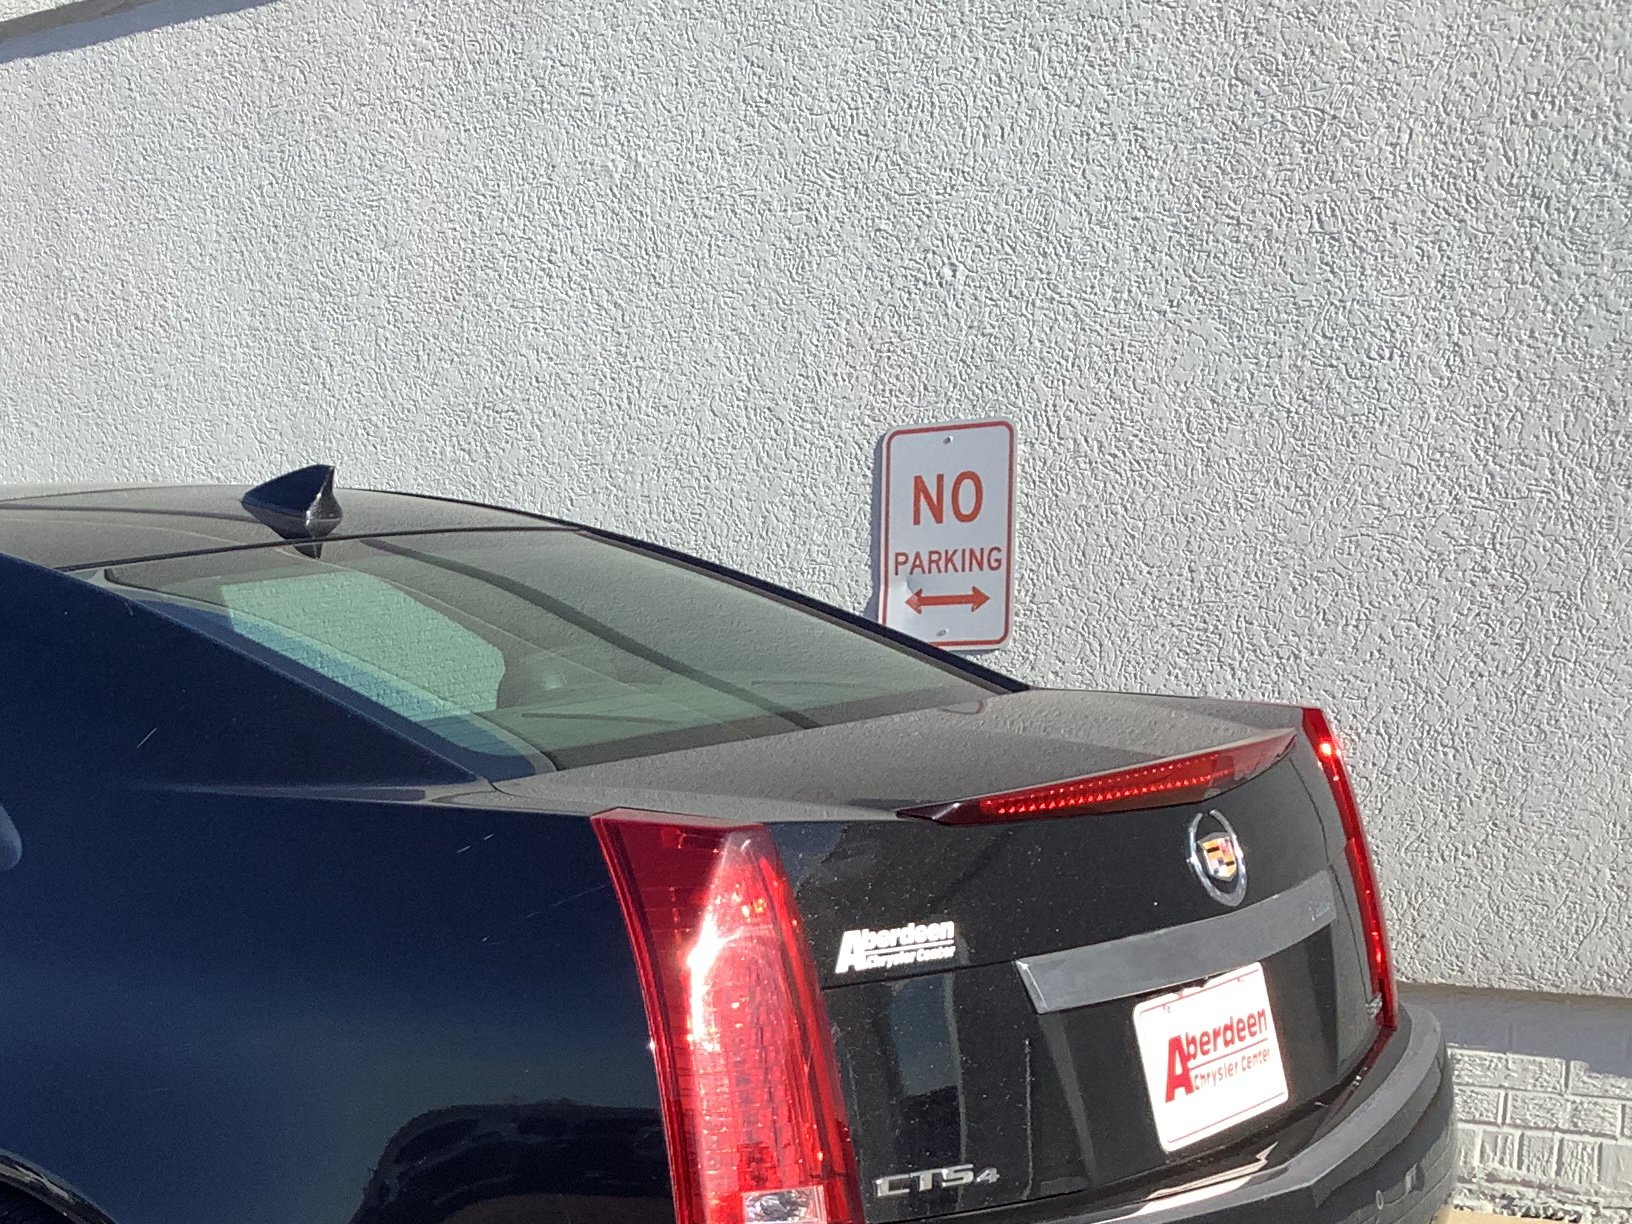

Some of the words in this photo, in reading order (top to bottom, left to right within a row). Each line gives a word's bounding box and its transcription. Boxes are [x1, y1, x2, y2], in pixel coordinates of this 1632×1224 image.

[912, 470, 984, 526] NO
[894, 546, 1003, 576] PARKING
[835, 920, 955, 974] Aberdeen
[1165, 1008, 1268, 1104] Aberdeen
[1194, 1061, 1239, 1090] Chrysler
[1241, 1048, 1270, 1072] Center
